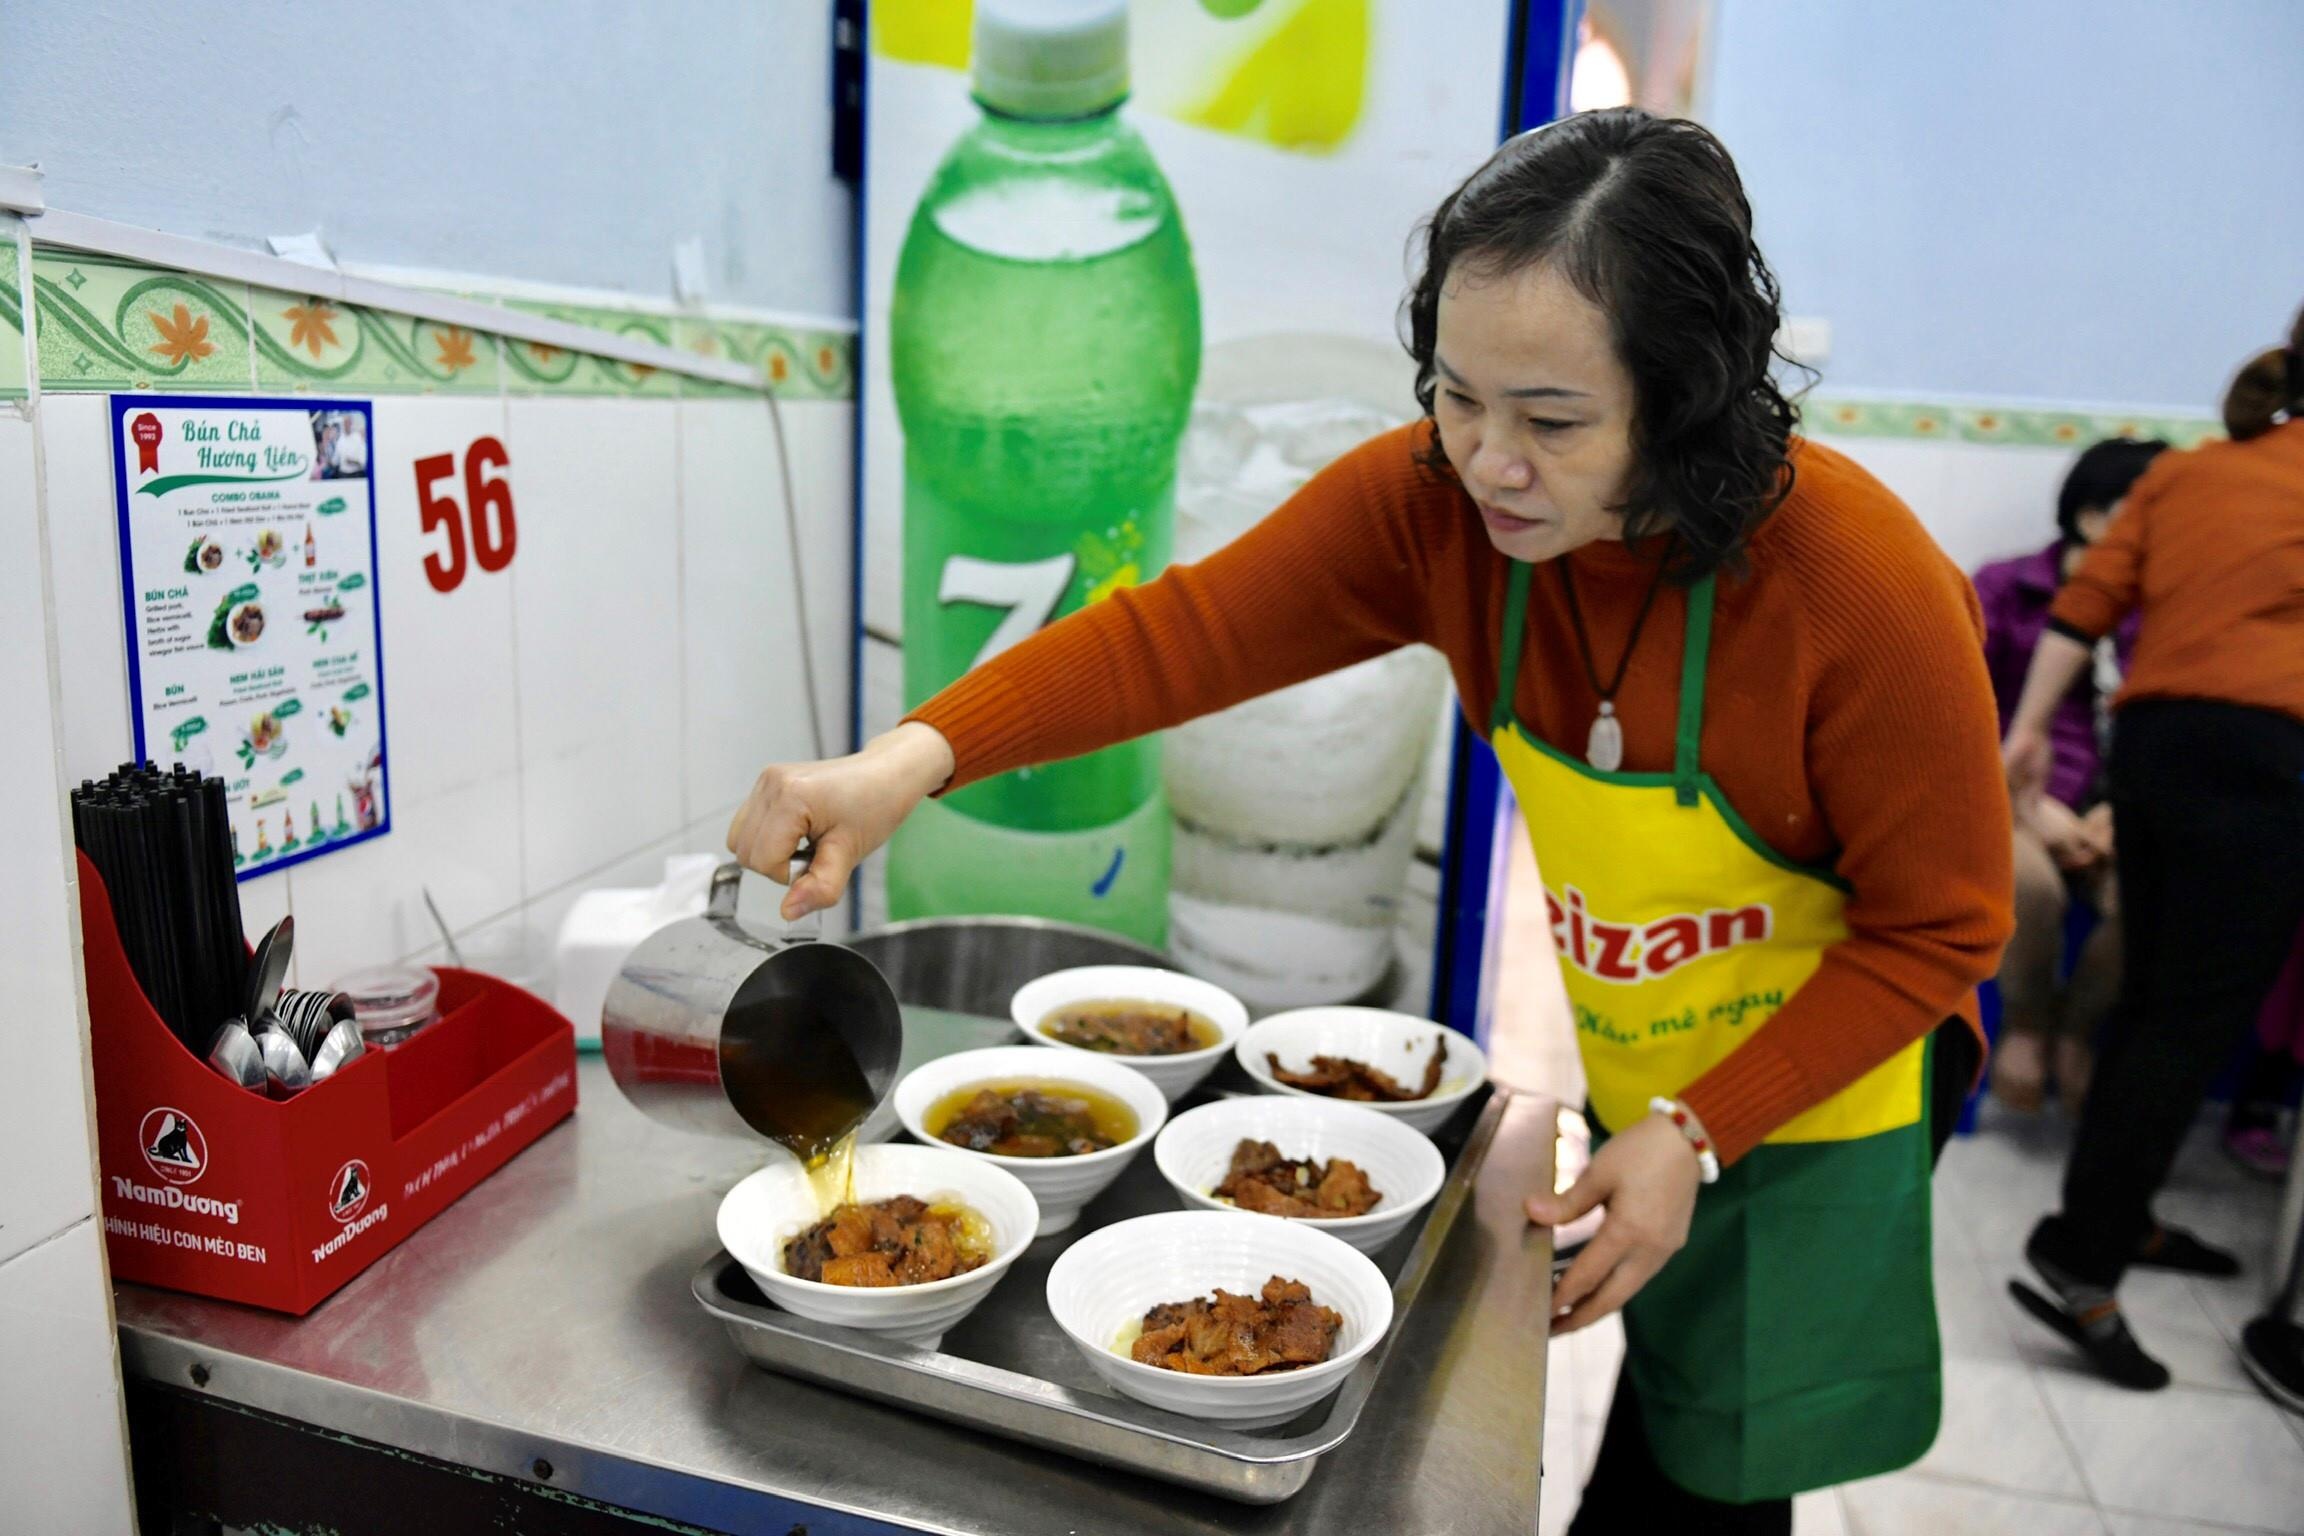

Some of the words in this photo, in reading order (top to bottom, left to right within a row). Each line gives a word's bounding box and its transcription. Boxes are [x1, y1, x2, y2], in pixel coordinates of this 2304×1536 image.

[137, 423, 157, 431] Since
[182, 419, 220, 442] Bún
[228, 419, 262, 442] Chả
[197, 445, 256, 473] Hương
[211, 492, 247, 503] COMBO
[249, 490, 280, 501] OBAMA
[413, 434, 517, 594] 56
[145, 588, 165, 602] BÚN
[167, 585, 189, 600] CHẢ
[145, 603, 167, 613] Grilled
[165, 685, 184, 696] BÚN
[112, 1176, 239, 1224] NamDương
[140, 1223, 172, 1245] HIỆU
[173, 1230, 202, 1251] CON
[237, 1243, 267, 1264] ĐEN
